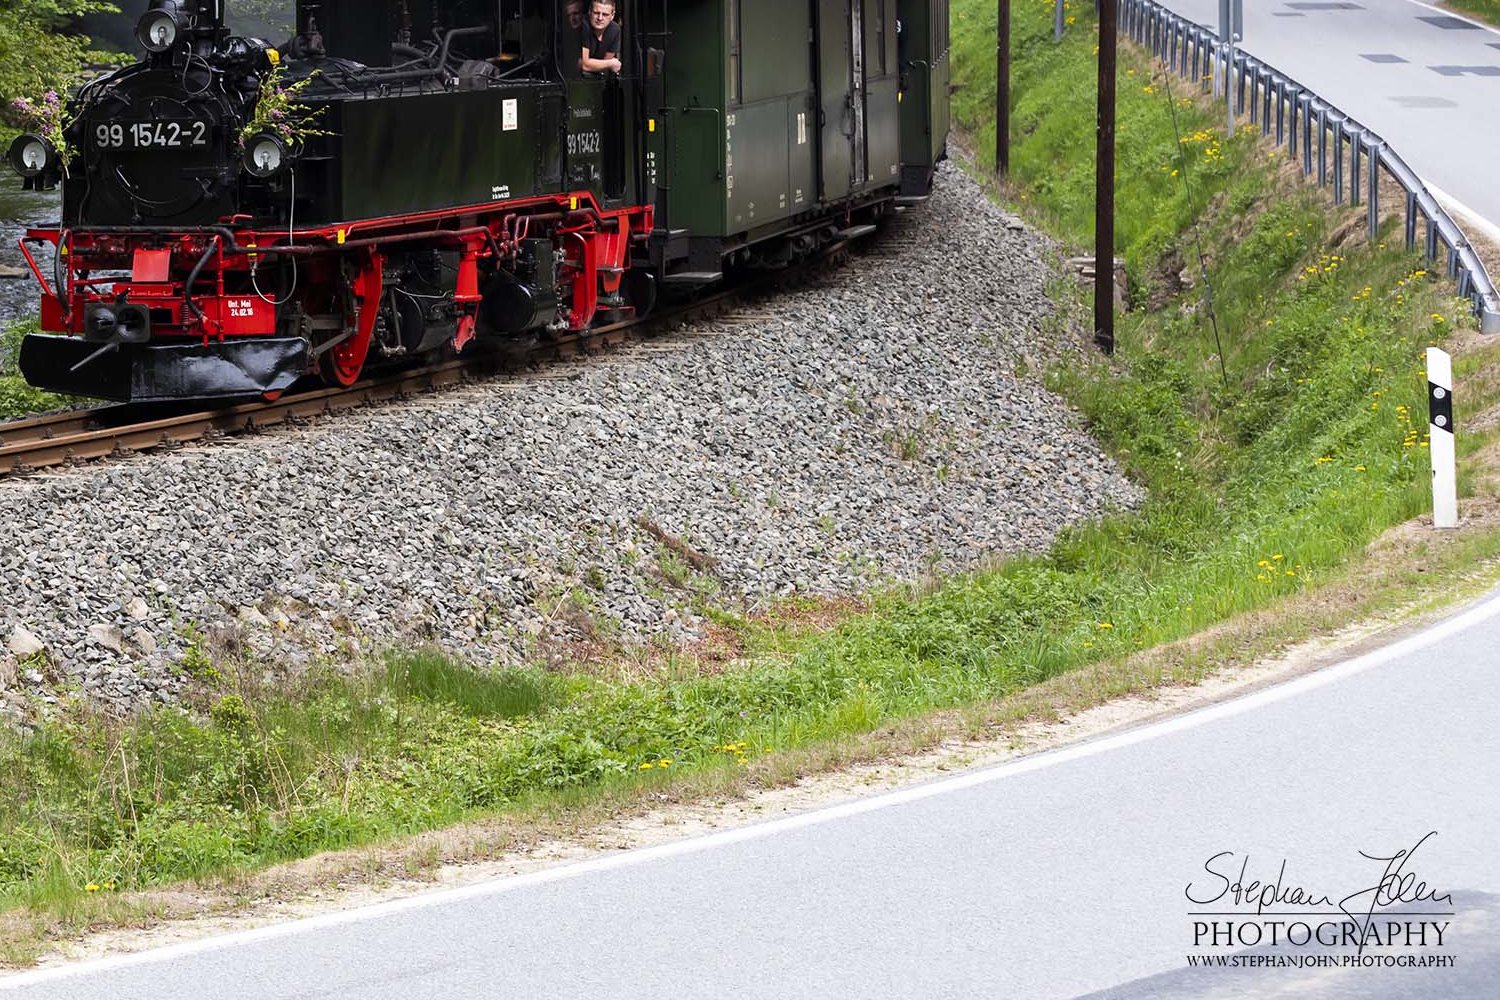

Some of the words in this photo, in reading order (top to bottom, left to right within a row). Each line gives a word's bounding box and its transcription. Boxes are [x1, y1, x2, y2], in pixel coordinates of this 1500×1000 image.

[96, 124, 123, 147] 99
[129, 121, 206, 147] 1542-2
[567, 133, 577, 154] 99
